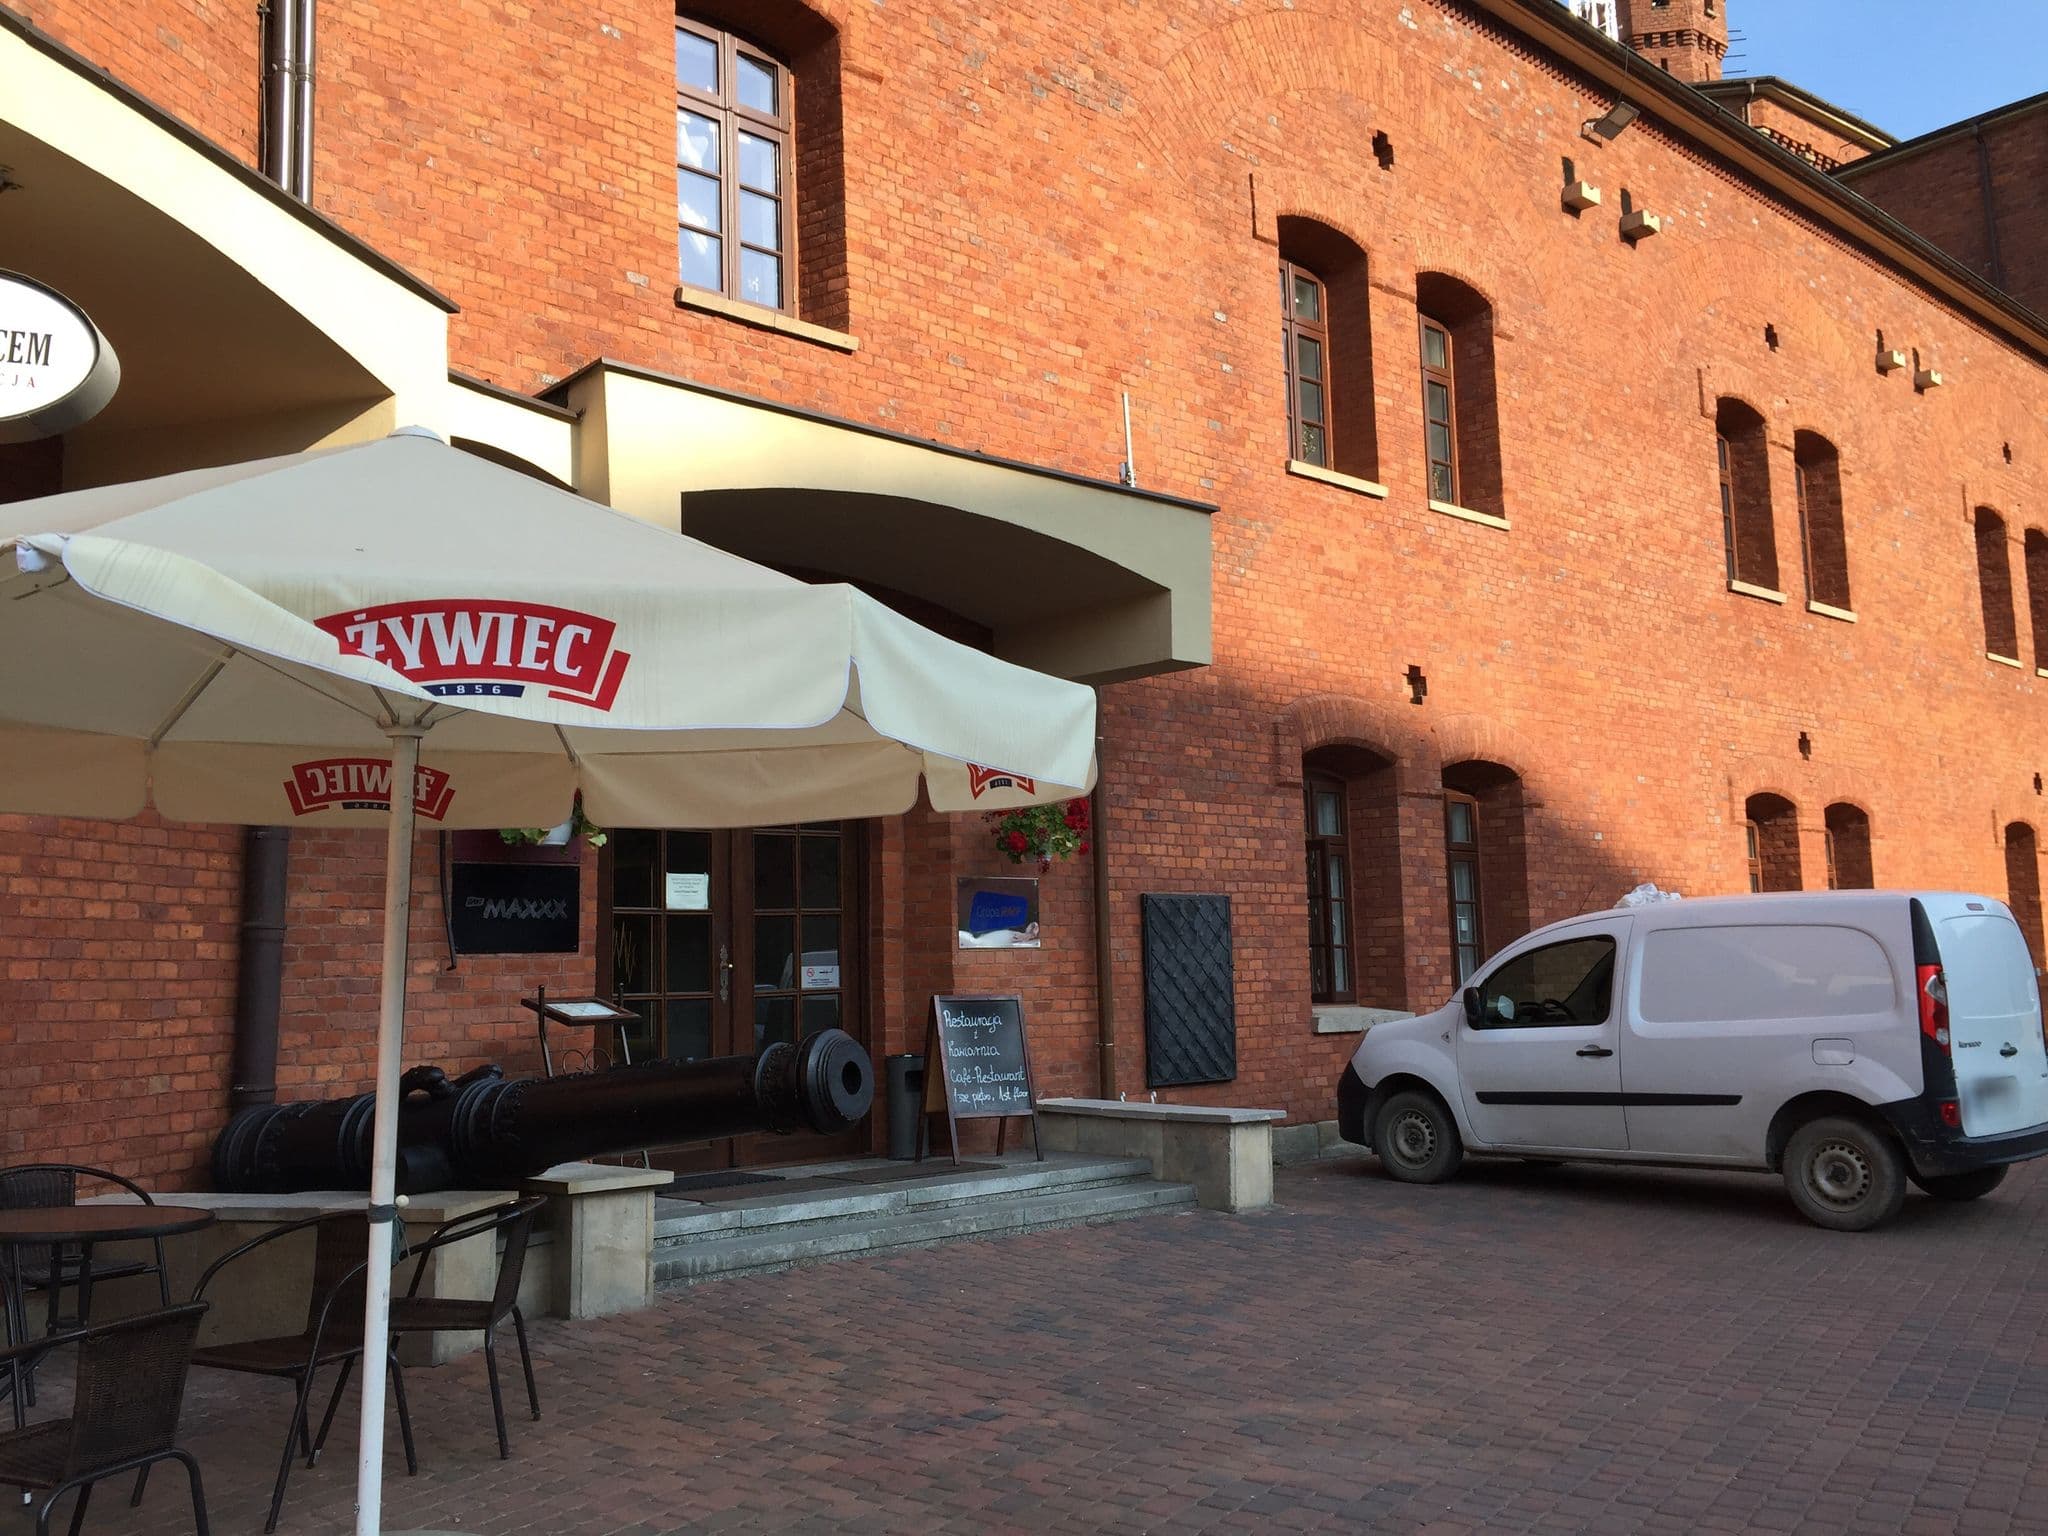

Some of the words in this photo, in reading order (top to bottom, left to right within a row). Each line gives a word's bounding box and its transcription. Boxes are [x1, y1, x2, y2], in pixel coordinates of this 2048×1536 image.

[344, 611, 593, 677] ŻYWIEC
[439, 684, 502, 696] 1856
[483, 897, 569, 920] MAXXX
